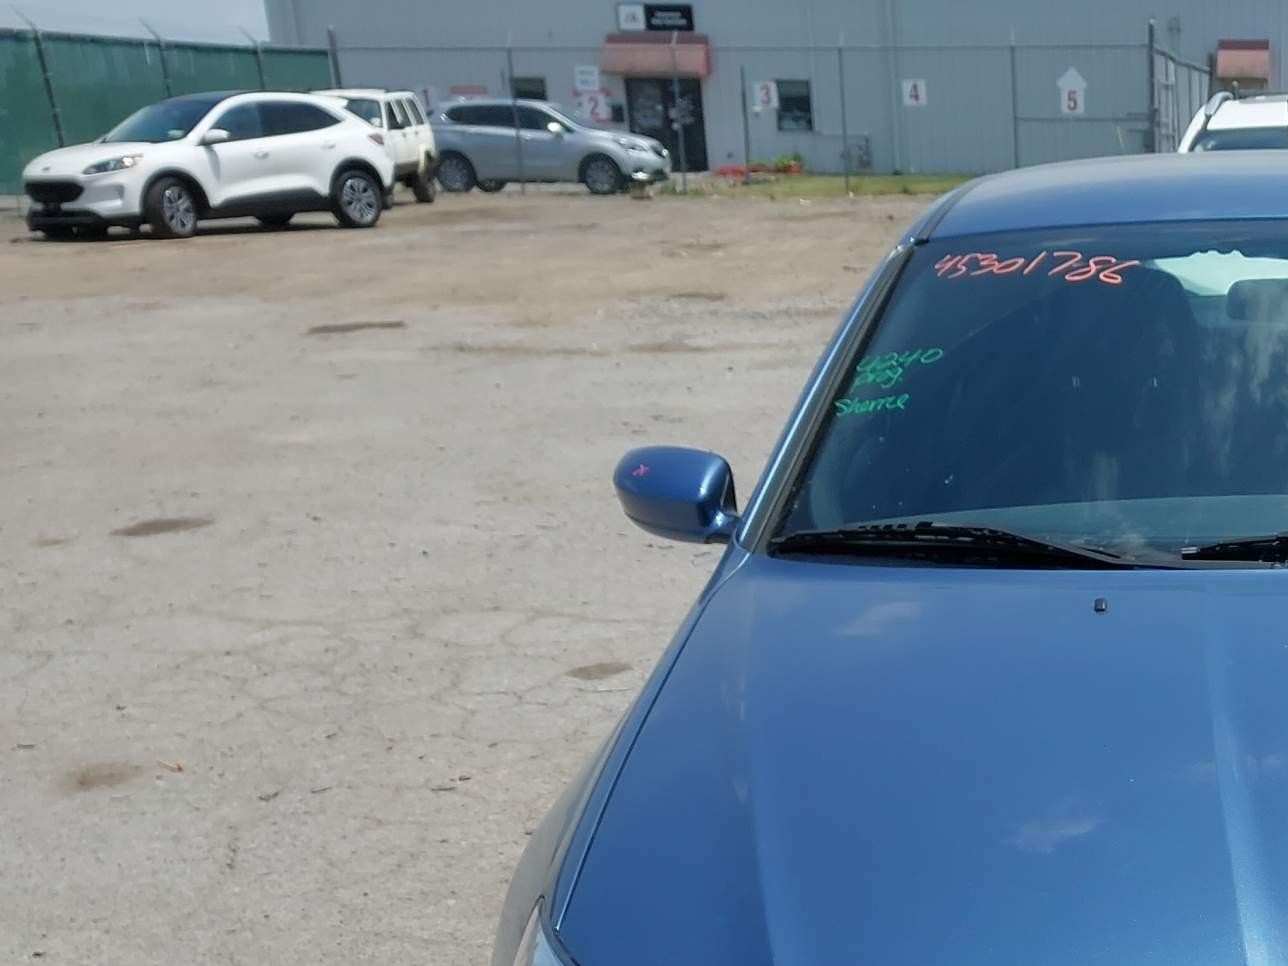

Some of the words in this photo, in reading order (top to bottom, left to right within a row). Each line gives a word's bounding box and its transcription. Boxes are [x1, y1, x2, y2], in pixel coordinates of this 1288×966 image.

[760, 85, 770, 105] 3
[908, 82, 919, 103] 4
[1067, 90, 1077, 112] 5
[587, 95, 599, 116] 2
[934, 250, 1141, 284] 45301786
